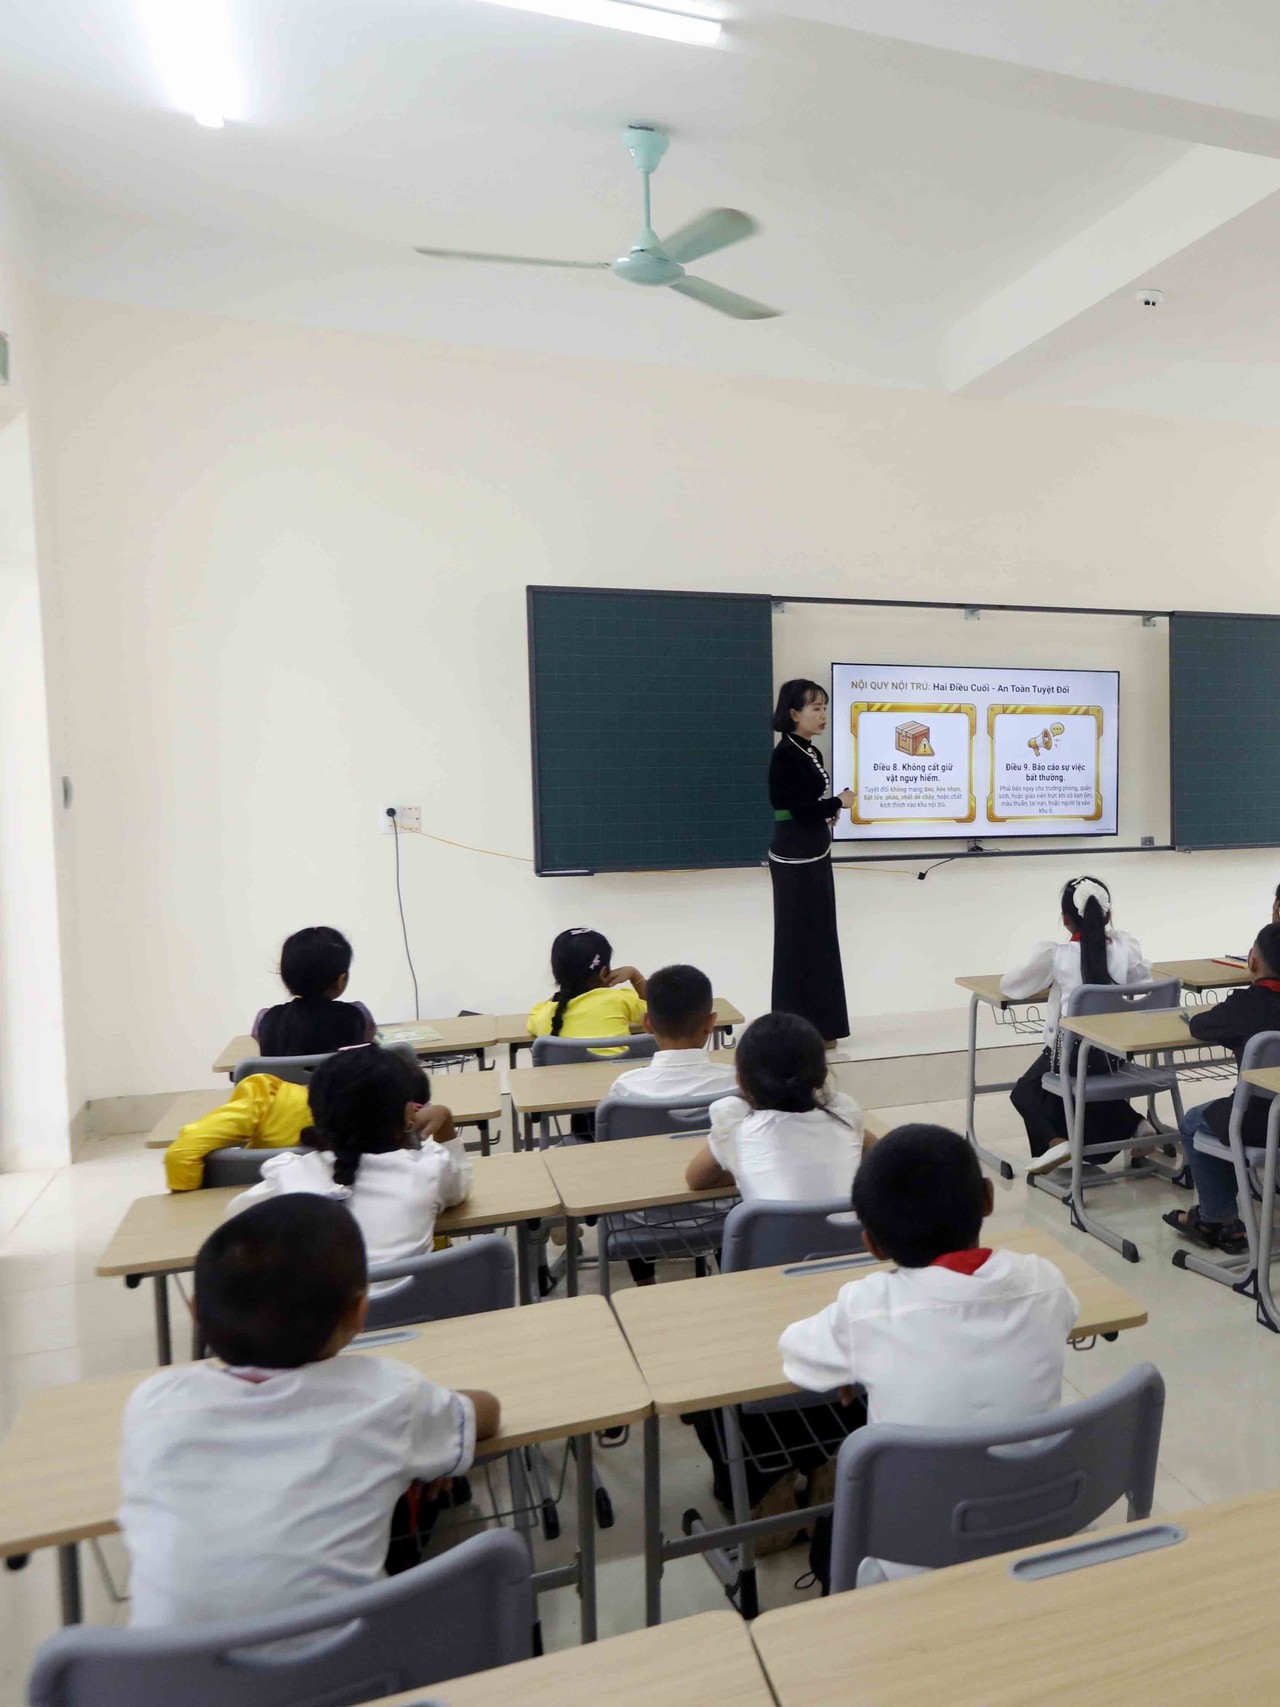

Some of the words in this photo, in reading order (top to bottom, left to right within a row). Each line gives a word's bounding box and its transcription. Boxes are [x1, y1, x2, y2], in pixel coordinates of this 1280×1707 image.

[851, 680, 868, 691] NỘI
[870, 681, 889, 690] QUY
[891, 680, 908, 691] NỘI
[932, 683, 947, 691] Hai
[949, 682, 968, 692] Điều
[970, 683, 990, 692] Cuối
[997, 684, 1009, 692] An
[1010, 684, 1030, 693] Toàn
[1032, 685, 1055, 695] Tuyệt
[1056, 685, 1070, 694] Đối
[873, 763, 890, 771] Điều
[892, 763, 900, 771] 8.
[902, 763, 925, 772] Không
[927, 763, 939, 771] cất
[941, 763, 953, 772] giữ
[1005, 763, 1022, 771] Điều
[1023, 763, 1030, 771] 9.
[1032, 763, 1046, 771] Báo
[1047, 763, 1060, 771] cáo
[1061, 764, 1070, 772] sự
[1071, 763, 1086, 772] việc
[886, 774, 898, 783] vật
[899, 775, 918, 783] nguy
[919, 773, 941, 782] hiểm.
[1026, 773, 1038, 782] bất
[1039, 773, 1066, 782] thường.
